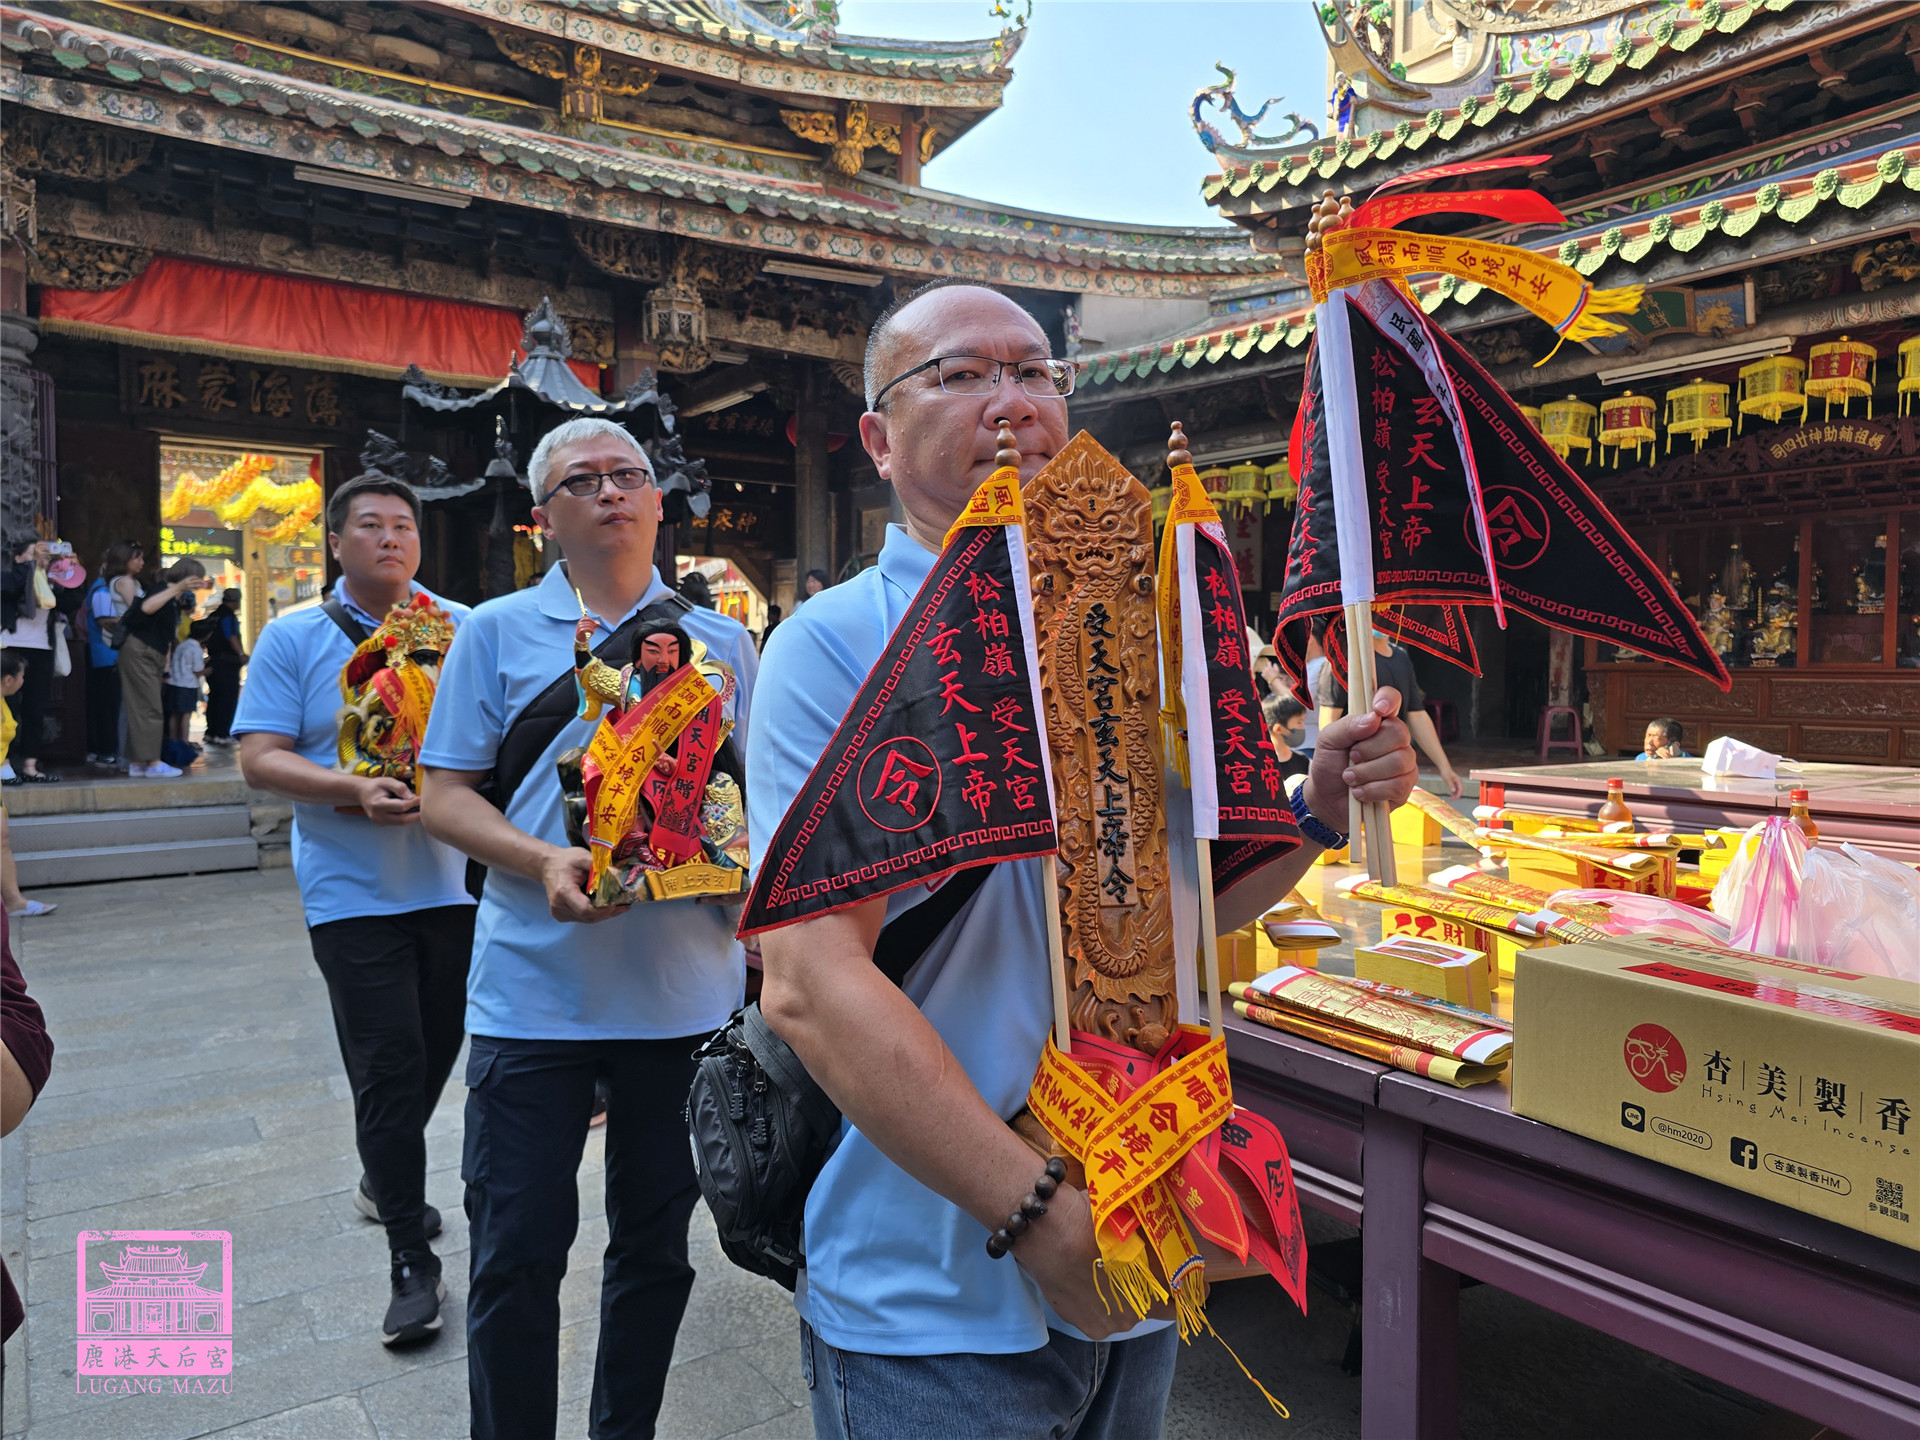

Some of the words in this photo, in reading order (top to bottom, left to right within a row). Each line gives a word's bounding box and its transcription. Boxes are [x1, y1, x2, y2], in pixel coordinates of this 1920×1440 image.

[1354, 239, 1446, 268] 風調雨順
[1457, 250, 1553, 300] 合境平安
[1370, 345, 1402, 451] 松柏嶺
[1376, 460, 1396, 560] 受天宮
[1402, 394, 1446, 557] 玄天上帝
[966, 571, 1018, 678] 松柏嶺
[1205, 566, 1244, 671] 松柏嶺
[649, 676, 710, 741] 風調雨順
[925, 621, 998, 824] 玄天上帝
[1217, 688, 1256, 795] 受天宮
[599, 745, 647, 826] 合境平安
[870, 749, 935, 818] 令
[991, 696, 1039, 811] 受天宮
[1082, 601, 1135, 904] 受天宮玄天上帝令
[1442, 922, 1464, 947] 財
[1626, 1111, 1640, 1122] LINE
[1657, 1122, 1705, 1146] @hm2020
[1702, 1084, 1757, 1115] Hsing
[1769, 1105, 1808, 1126] Mei
[1823, 1119, 1912, 1156] Incense
[1773, 1158, 1841, 1190] 杏美製香HM
[1868, 1201, 1910, 1224] 參觀選購
